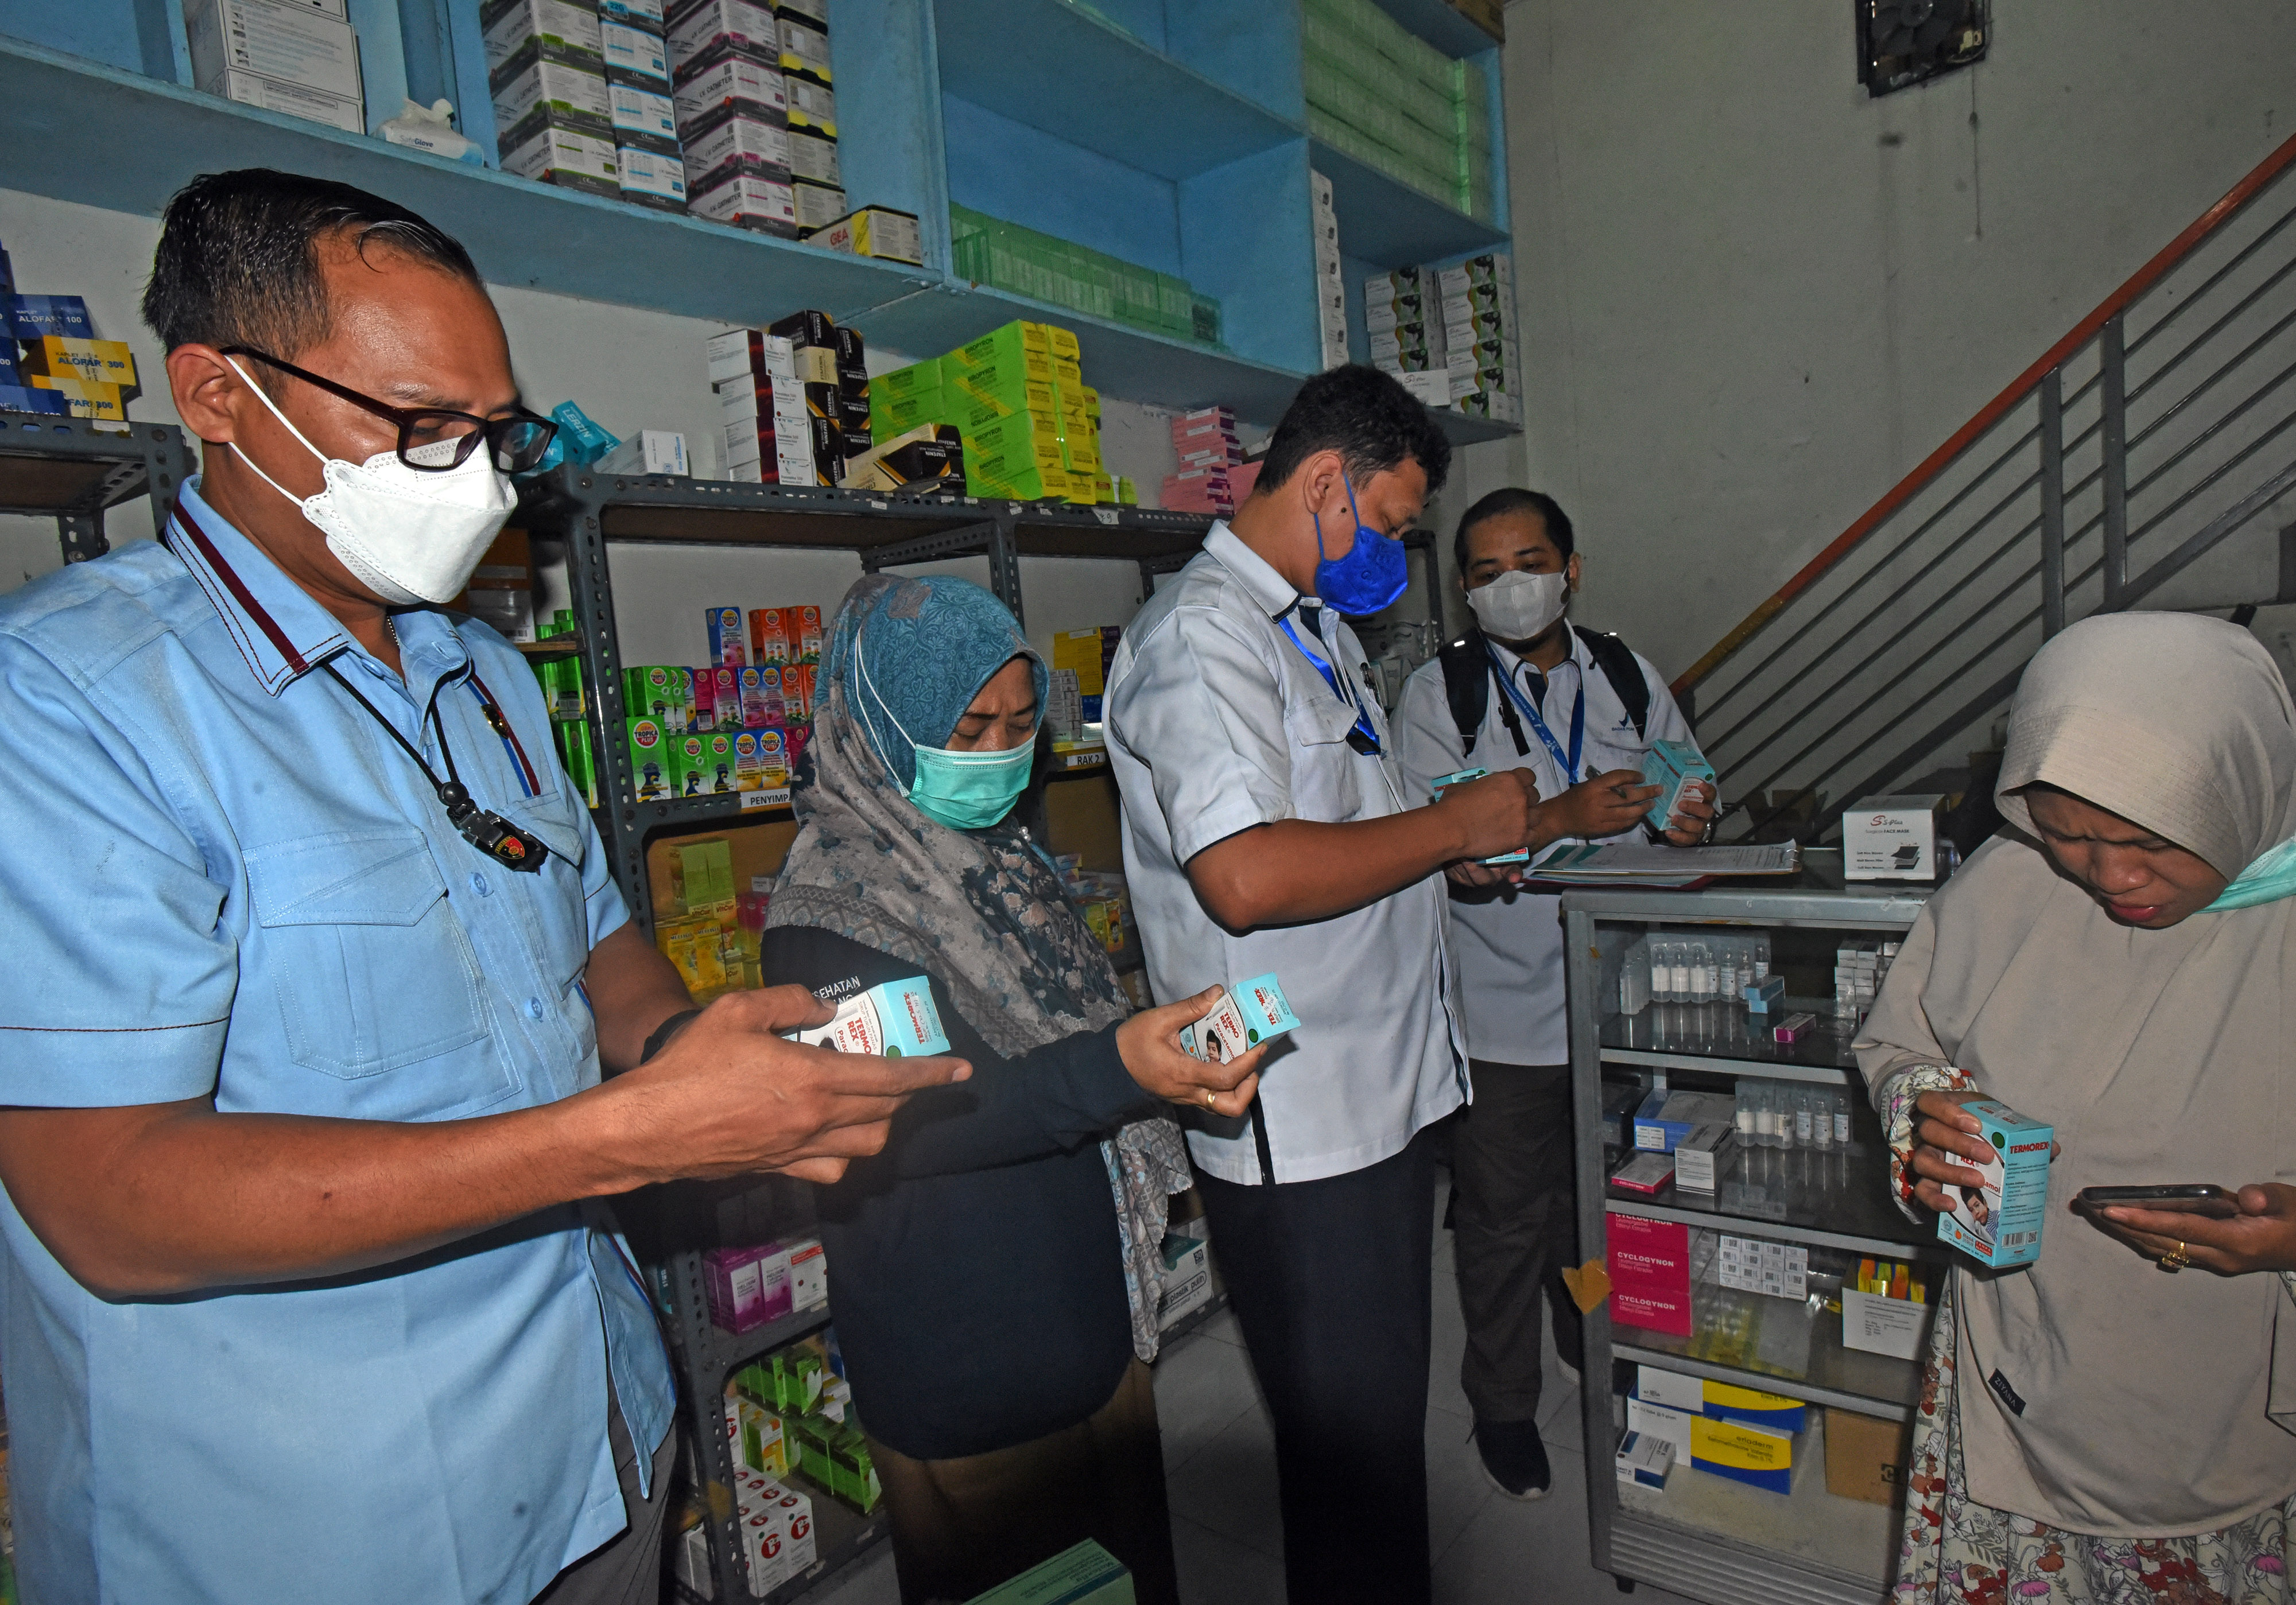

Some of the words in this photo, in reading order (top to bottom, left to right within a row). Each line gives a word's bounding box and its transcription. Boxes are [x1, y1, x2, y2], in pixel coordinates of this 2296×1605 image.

[705, 75, 732, 95] CATHETER
[717, 192, 742, 209] CATHETER
[830, 228, 848, 246] GEA
[844, 330, 853, 355] ETAFENIN
[965, 337, 994, 354] BIROPYRON
[59, 356, 102, 367] ALOFAR
[846, 372, 867, 380] ETAFENIN
[968, 366, 996, 382] BIROPYRON
[68, 398, 90, 407] FAR
[848, 405, 868, 413] ETAFENIN
[975, 427, 1002, 442] BIROPYRON
[979, 456, 1004, 470] BIROPYRON
[1077, 755, 1093, 766] RAK
[1095, 754, 1100, 763] 2
[813, 976, 861, 1000] SEHATAN
[903, 993, 925, 1045] TERMOREX
[1220, 1015, 1229, 1030] REX
[1224, 1012, 1239, 1039] TERMO
[847, 1020, 859, 1042] REX
[855, 1017, 871, 1055] TERMO
[863, 1016, 871, 1032] TURUN
[869, 1032, 878, 1051] PANAS
[1215, 1023, 1235, 1059] Paracetamo
[2010, 1141, 2049, 1154] TERMOREX
[1960, 1156, 1975, 1167] REX
[1963, 1233, 1975, 1242] Rasa
[1194, 1252, 1203, 1260] 30
[1618, 1252, 1674, 1267] CYCLOGYNON
[1170, 1285, 1189, 1304] plastik
[1190, 1276, 1205, 1292] putih
[1619, 1295, 1676, 1311] CYCLOGYNON
[1994, 1375, 2016, 1408] ZIYANA
[1736, 1435, 1774, 1450] erladerm
[1747, 1452, 1759, 1460] Krim
